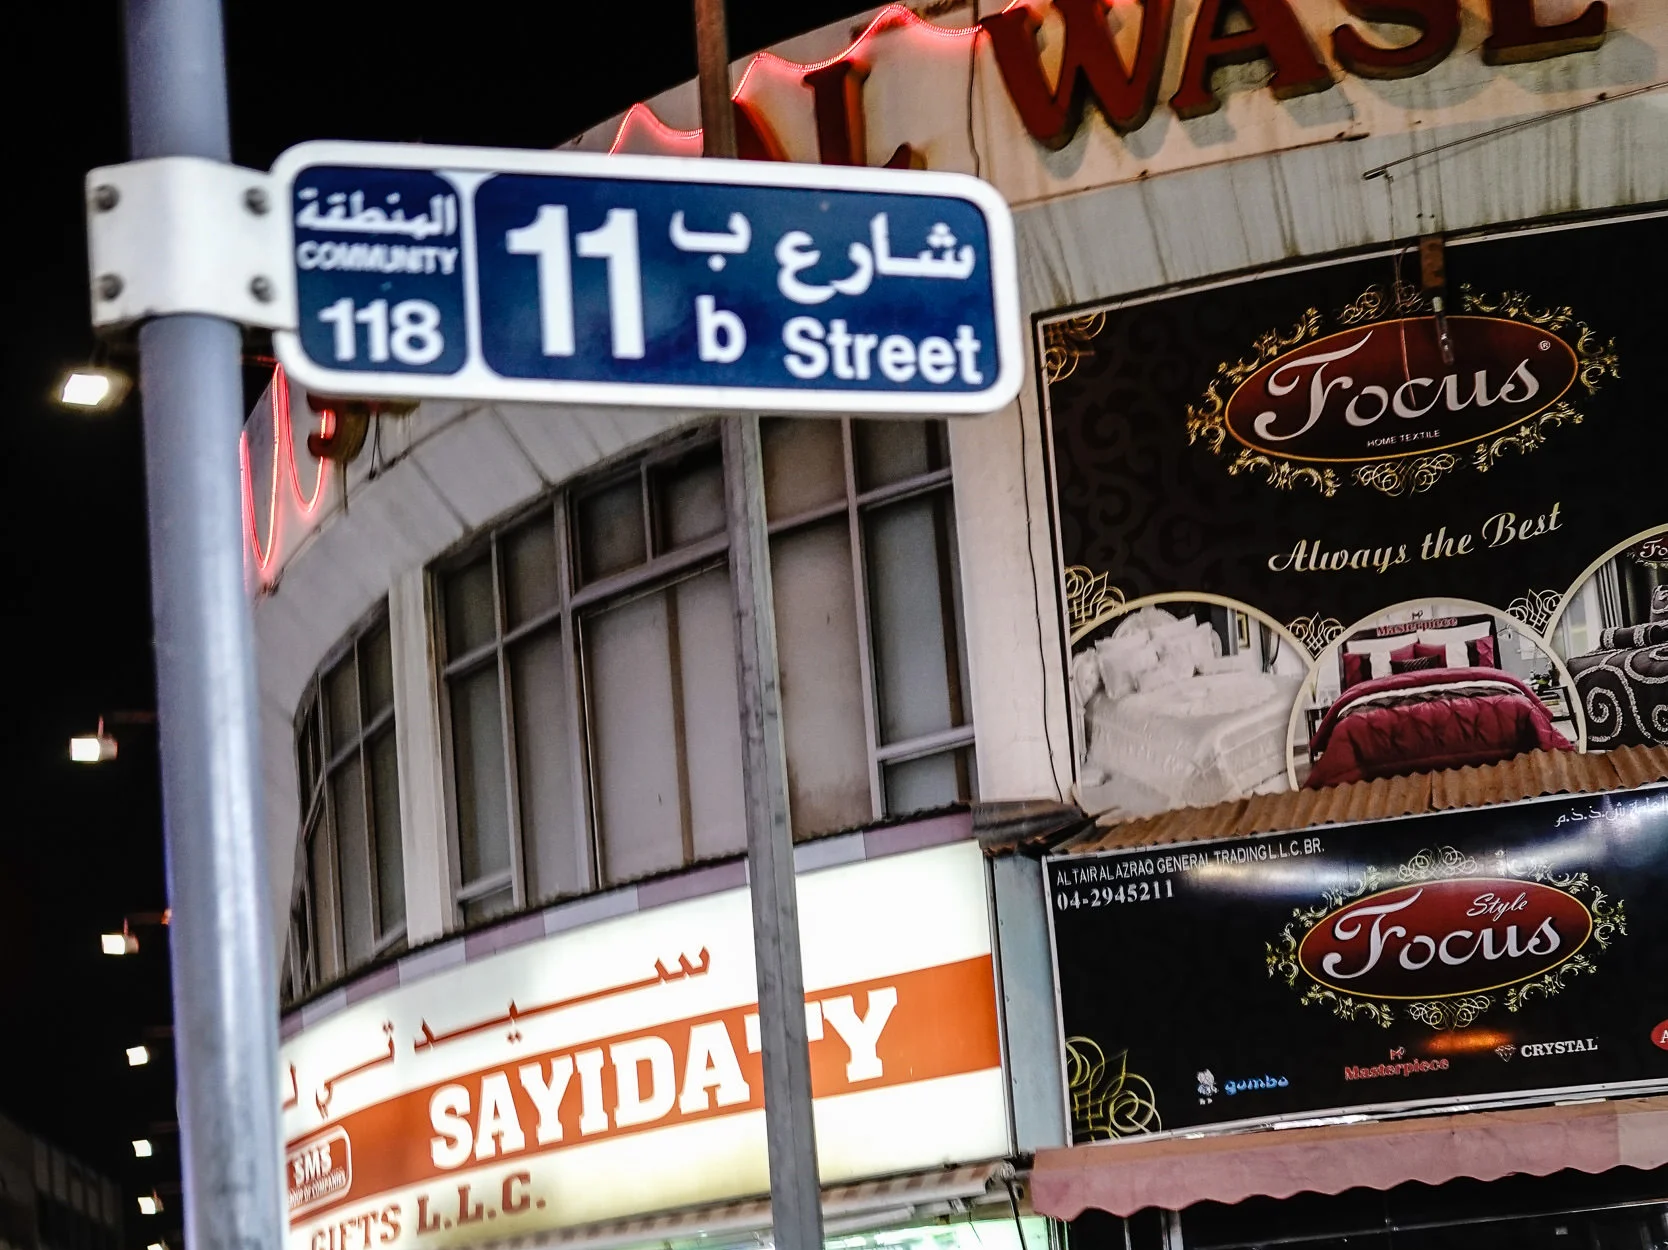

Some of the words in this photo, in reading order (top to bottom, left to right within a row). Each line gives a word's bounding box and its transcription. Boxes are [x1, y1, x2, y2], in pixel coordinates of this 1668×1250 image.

[296, 187, 457, 241] المنطقة
[297, 241, 459, 275] COMMUNITY
[669, 211, 752, 272] ب
[774, 211, 977, 304] شارع
[505, 204, 645, 360] 11
[318, 297, 445, 366] 118
[695, 295, 747, 363] b
[782, 316, 984, 385] Street
[1253, 330, 1540, 441] Focus
[1367, 436, 1397, 447] HOME
[1400, 429, 1441, 442] TEXTILE
[1267, 538, 1411, 574] Always
[1420, 526, 1475, 561] the
[1481, 502, 1563, 548] Best
[1376, 616, 1459, 637] Masterpiece
[1056, 870, 1072, 886] AL
[1072, 865, 1098, 884] TAIR
[1099, 864, 1115, 881] AL
[1115, 858, 1155, 879] AZRAQ
[1157, 851, 1210, 874] GENERAL
[1213, 844, 1267, 865] TRADING
[1303, 837, 1325, 855] BR.
[1057, 879, 1174, 911] 04-2945211
[1466, 891, 1529, 923] Style
[1322, 888, 1561, 980] Focus
[1344, 1058, 1450, 1082] Masterpiece
[1521, 1038, 1599, 1059] CRYSTAL
[292, 1142, 333, 1185] SMS
[415, 1171, 547, 1237] L.L.C.
